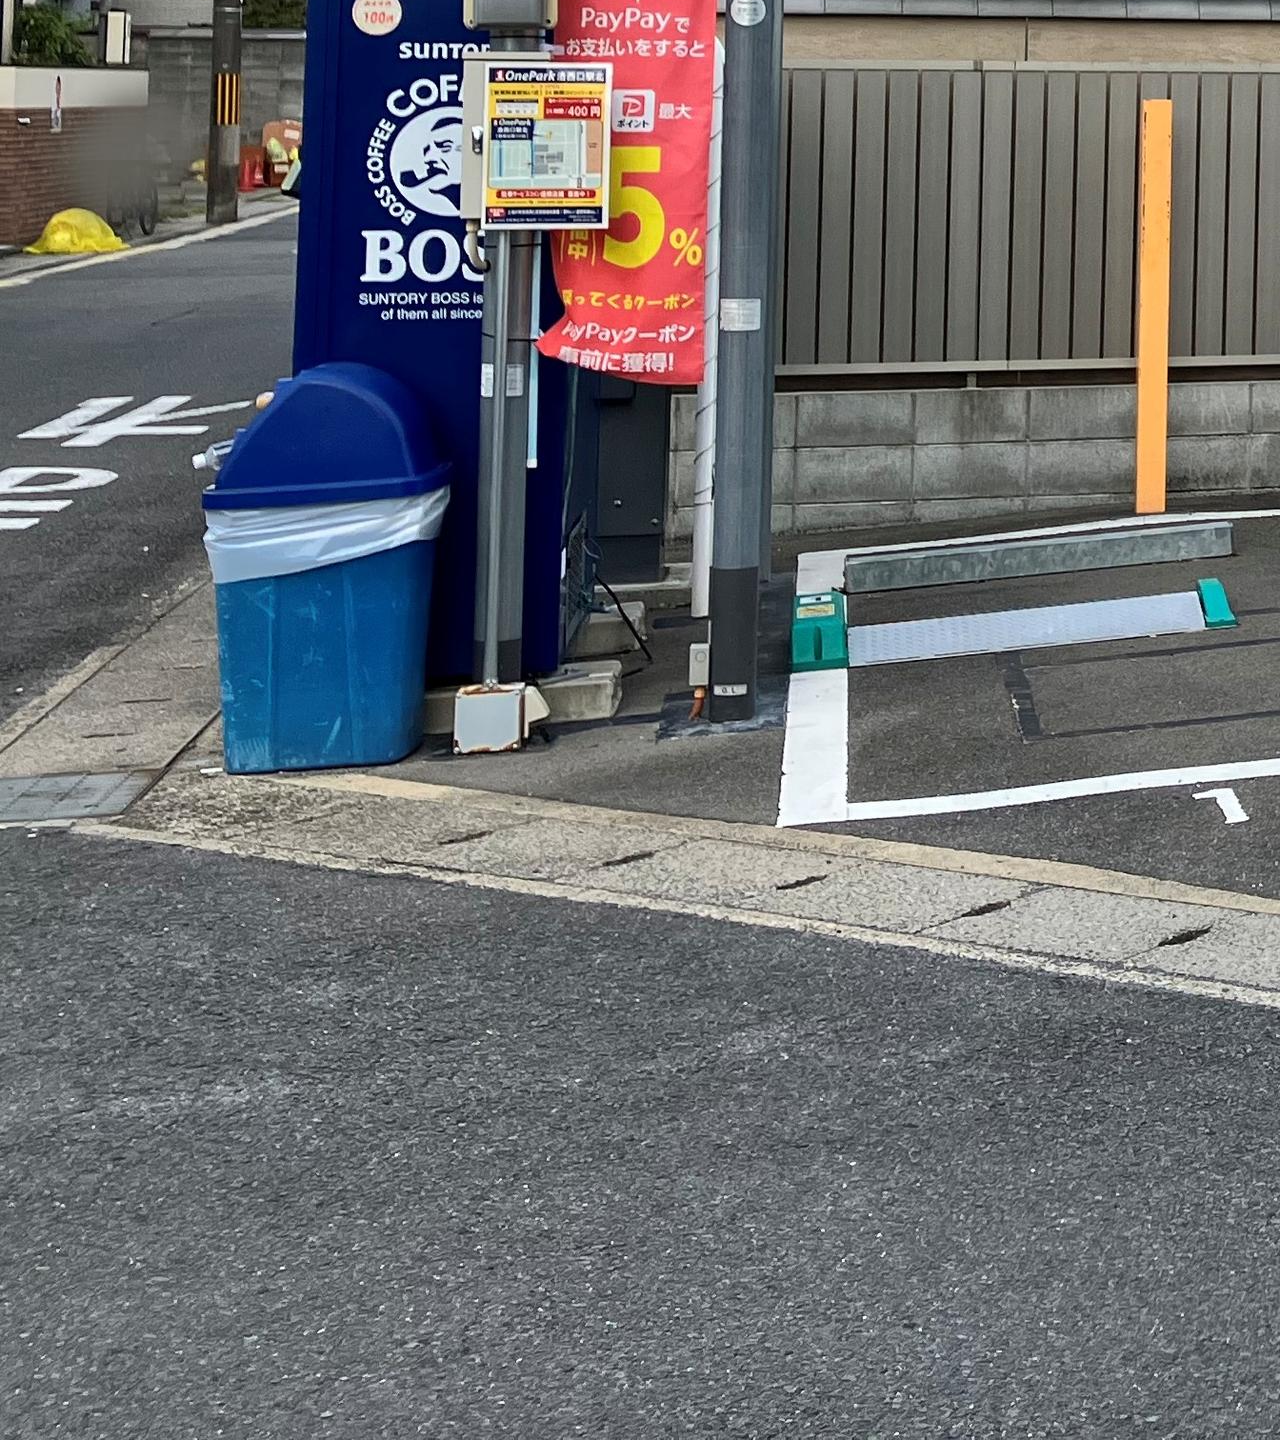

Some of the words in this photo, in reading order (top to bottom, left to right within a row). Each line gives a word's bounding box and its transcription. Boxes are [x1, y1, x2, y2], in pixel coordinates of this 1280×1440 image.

[566, 37, 706, 58] お支払いをすると
[658, 102, 693, 120] 最大
[616, 118, 650, 129] ポイント
[366, 118, 397, 184] COFFEE
[374, 185, 417, 226] BOSS
[359, 292, 428, 305] SUNTORY
[431, 292, 470, 304] BOSS
[473, 292, 484, 304] is
[381, 308, 394, 320] of
[397, 308, 428, 320] them
[431, 308, 447, 320] all
[450, 308, 483, 320] since
[561, 320, 696, 346] PayPayクーポン
